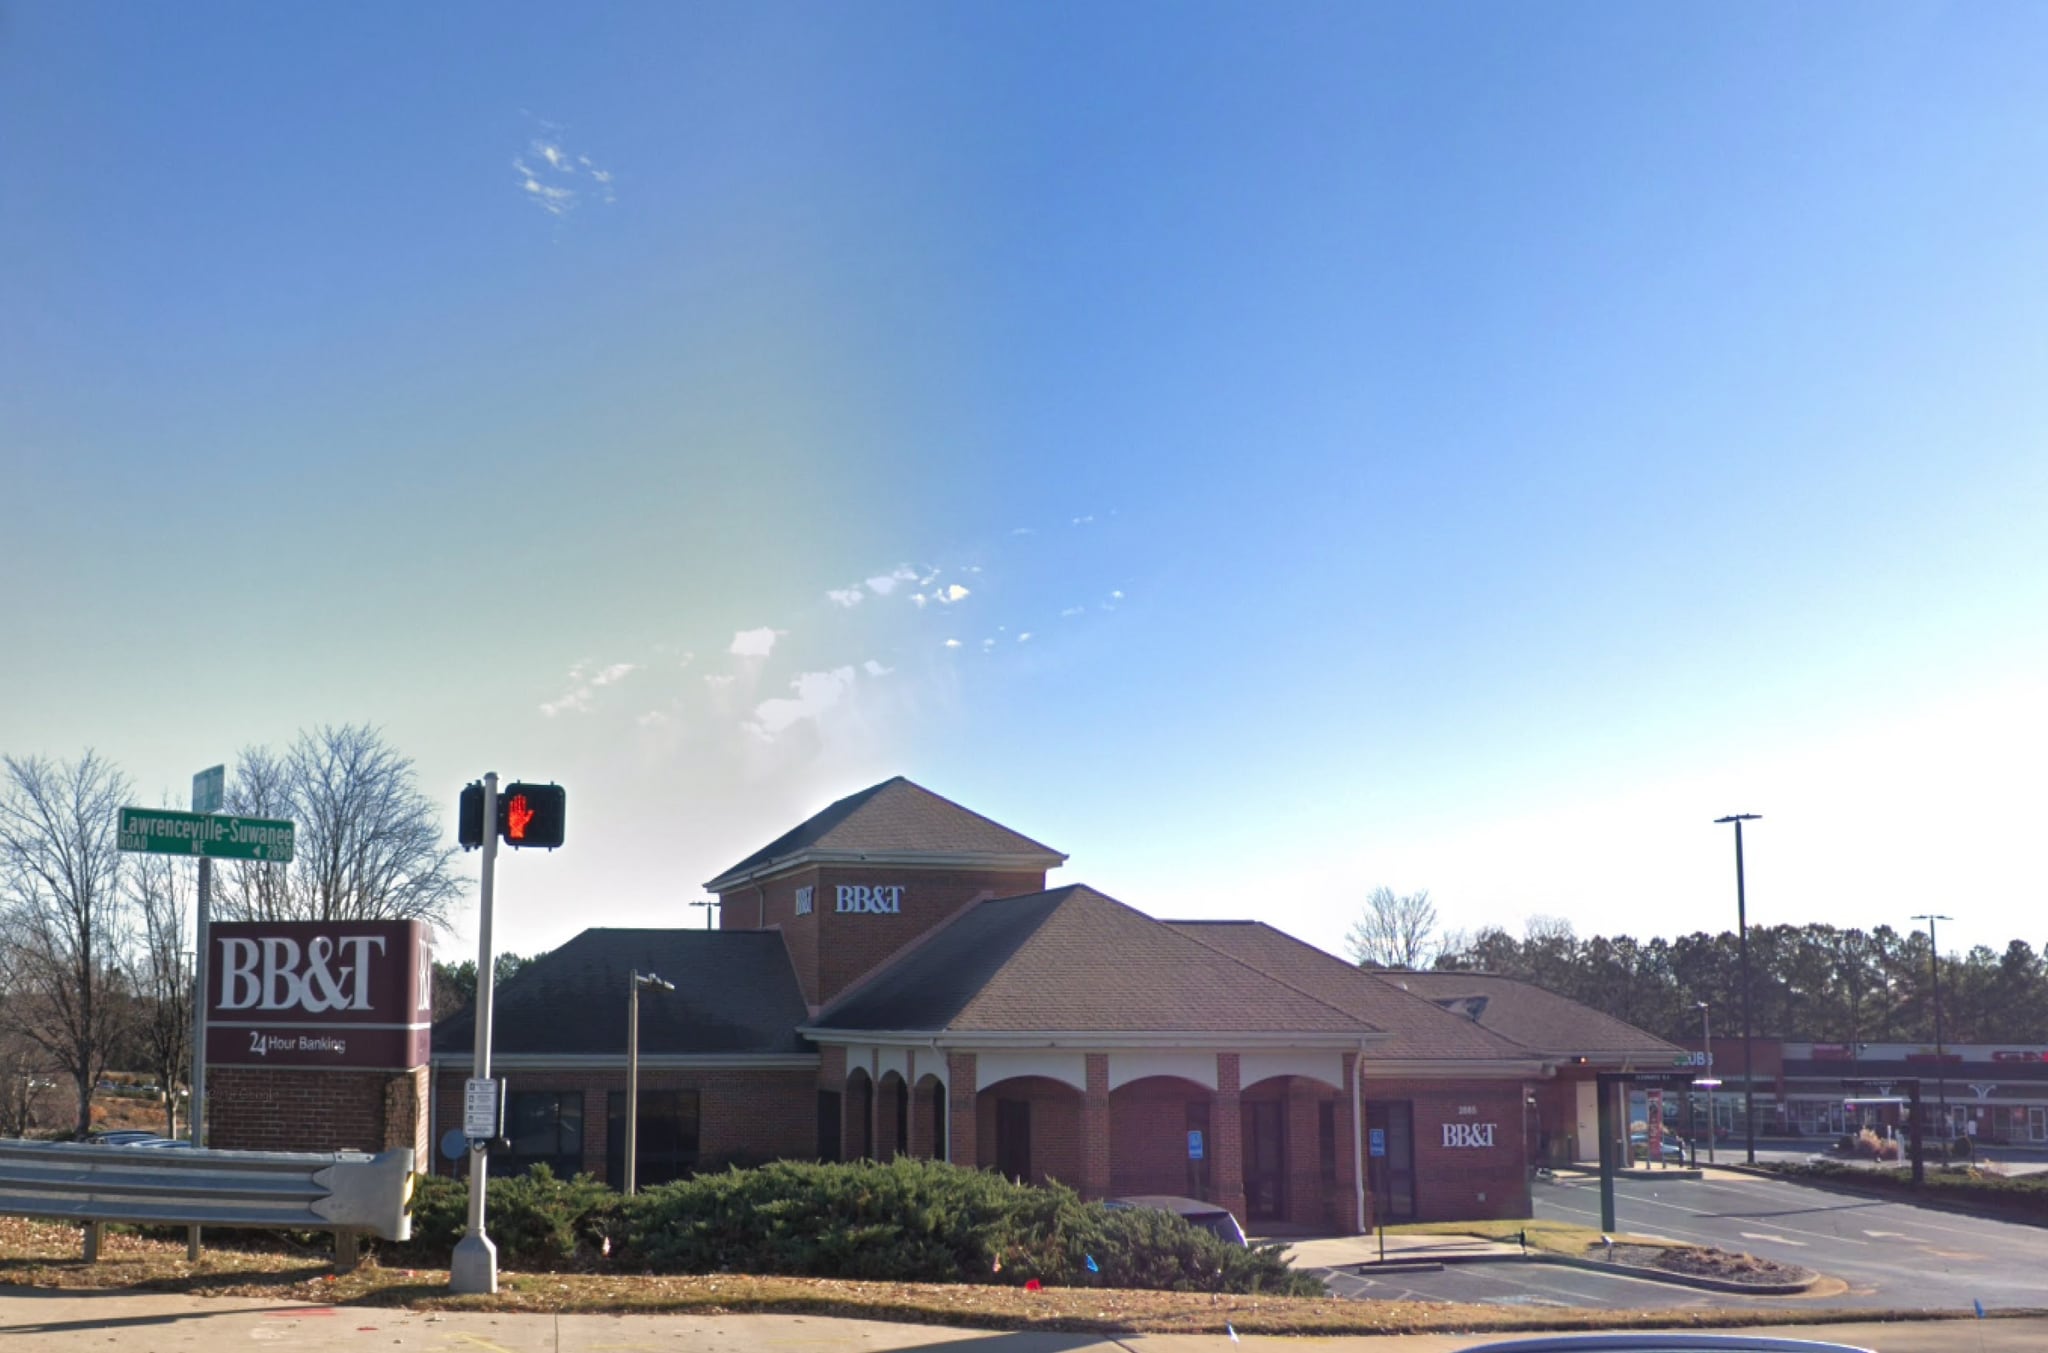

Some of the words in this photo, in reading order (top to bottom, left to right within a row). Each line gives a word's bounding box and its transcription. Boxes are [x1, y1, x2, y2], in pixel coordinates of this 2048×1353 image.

[120, 810, 293, 844] Lawrenceville-Suwanee
[119, 835, 148, 850] ROAD
[191, 840, 205, 854] NE
[835, 885, 905, 914] BB&T
[216, 936, 386, 1013] BB&T
[249, 1031, 267, 1056] 24
[268, 1036, 296, 1050] Hour
[299, 1036, 346, 1054] Banking
[1442, 1123, 1498, 1147] BB&T
